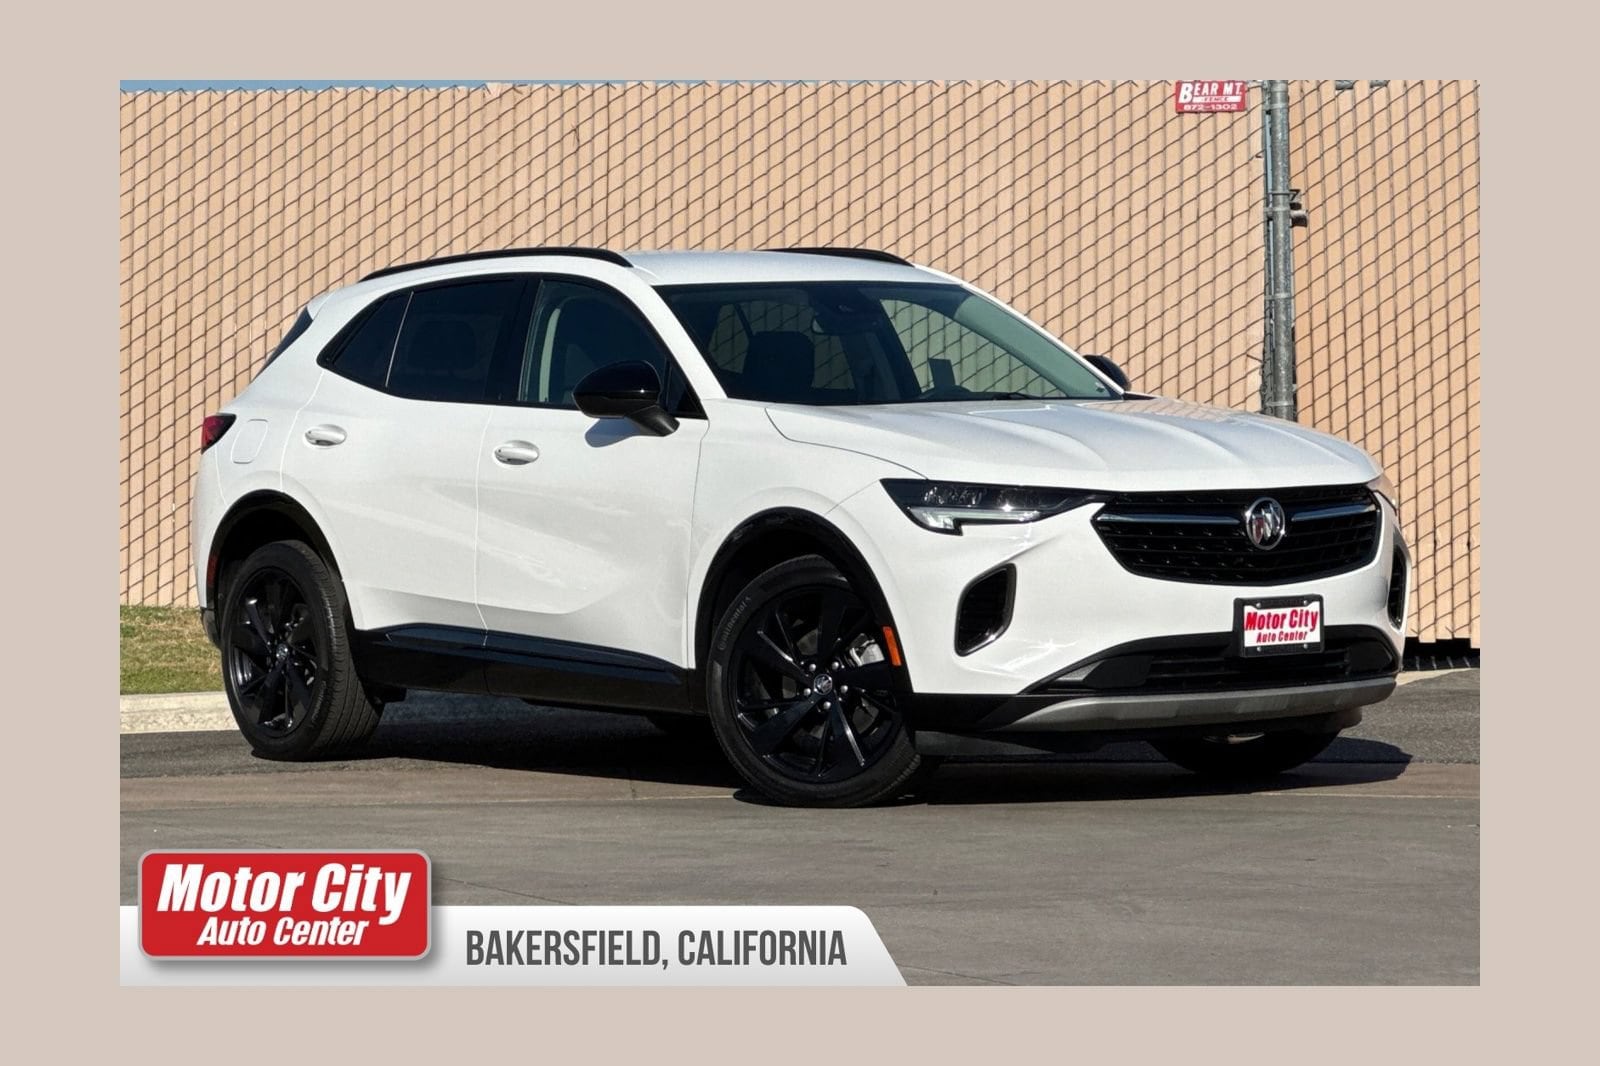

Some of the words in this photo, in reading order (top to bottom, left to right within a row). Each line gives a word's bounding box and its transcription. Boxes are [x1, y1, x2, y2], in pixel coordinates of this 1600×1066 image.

[1178, 82, 1220, 103] BEAR
[1245, 611, 1287, 631] Motor
[1289, 609, 1319, 632] City
[1256, 632, 1276, 643] Auto
[1278, 631, 1308, 642] Center
